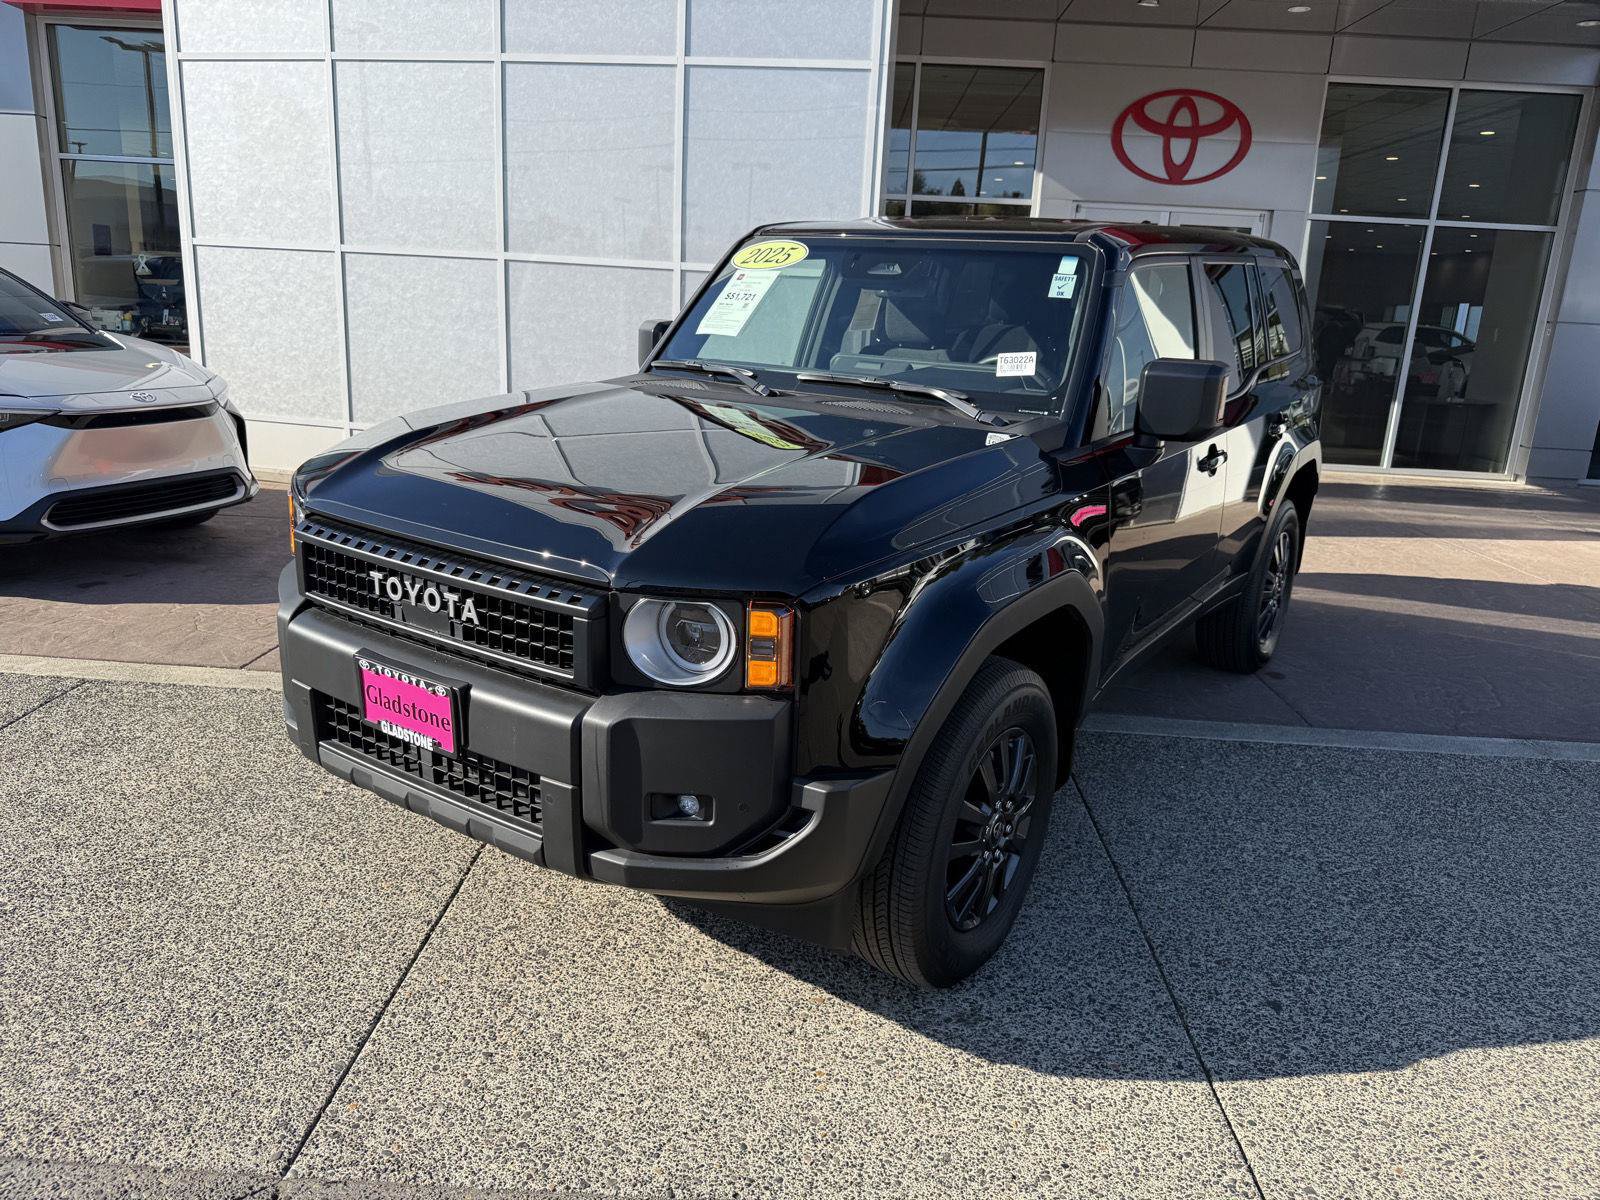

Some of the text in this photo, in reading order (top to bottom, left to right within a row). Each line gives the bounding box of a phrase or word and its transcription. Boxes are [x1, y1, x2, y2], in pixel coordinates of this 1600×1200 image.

[741, 247, 799, 264] 2025
[724, 292, 758, 302] $51,721
[999, 355, 1034, 364] T63022A
[369, 571, 480, 625] TOYOTA
[376, 664, 427, 690] TOYOTA
[365, 684, 451, 732] Gladstone
[380, 720, 434, 751] GLADSTONE
